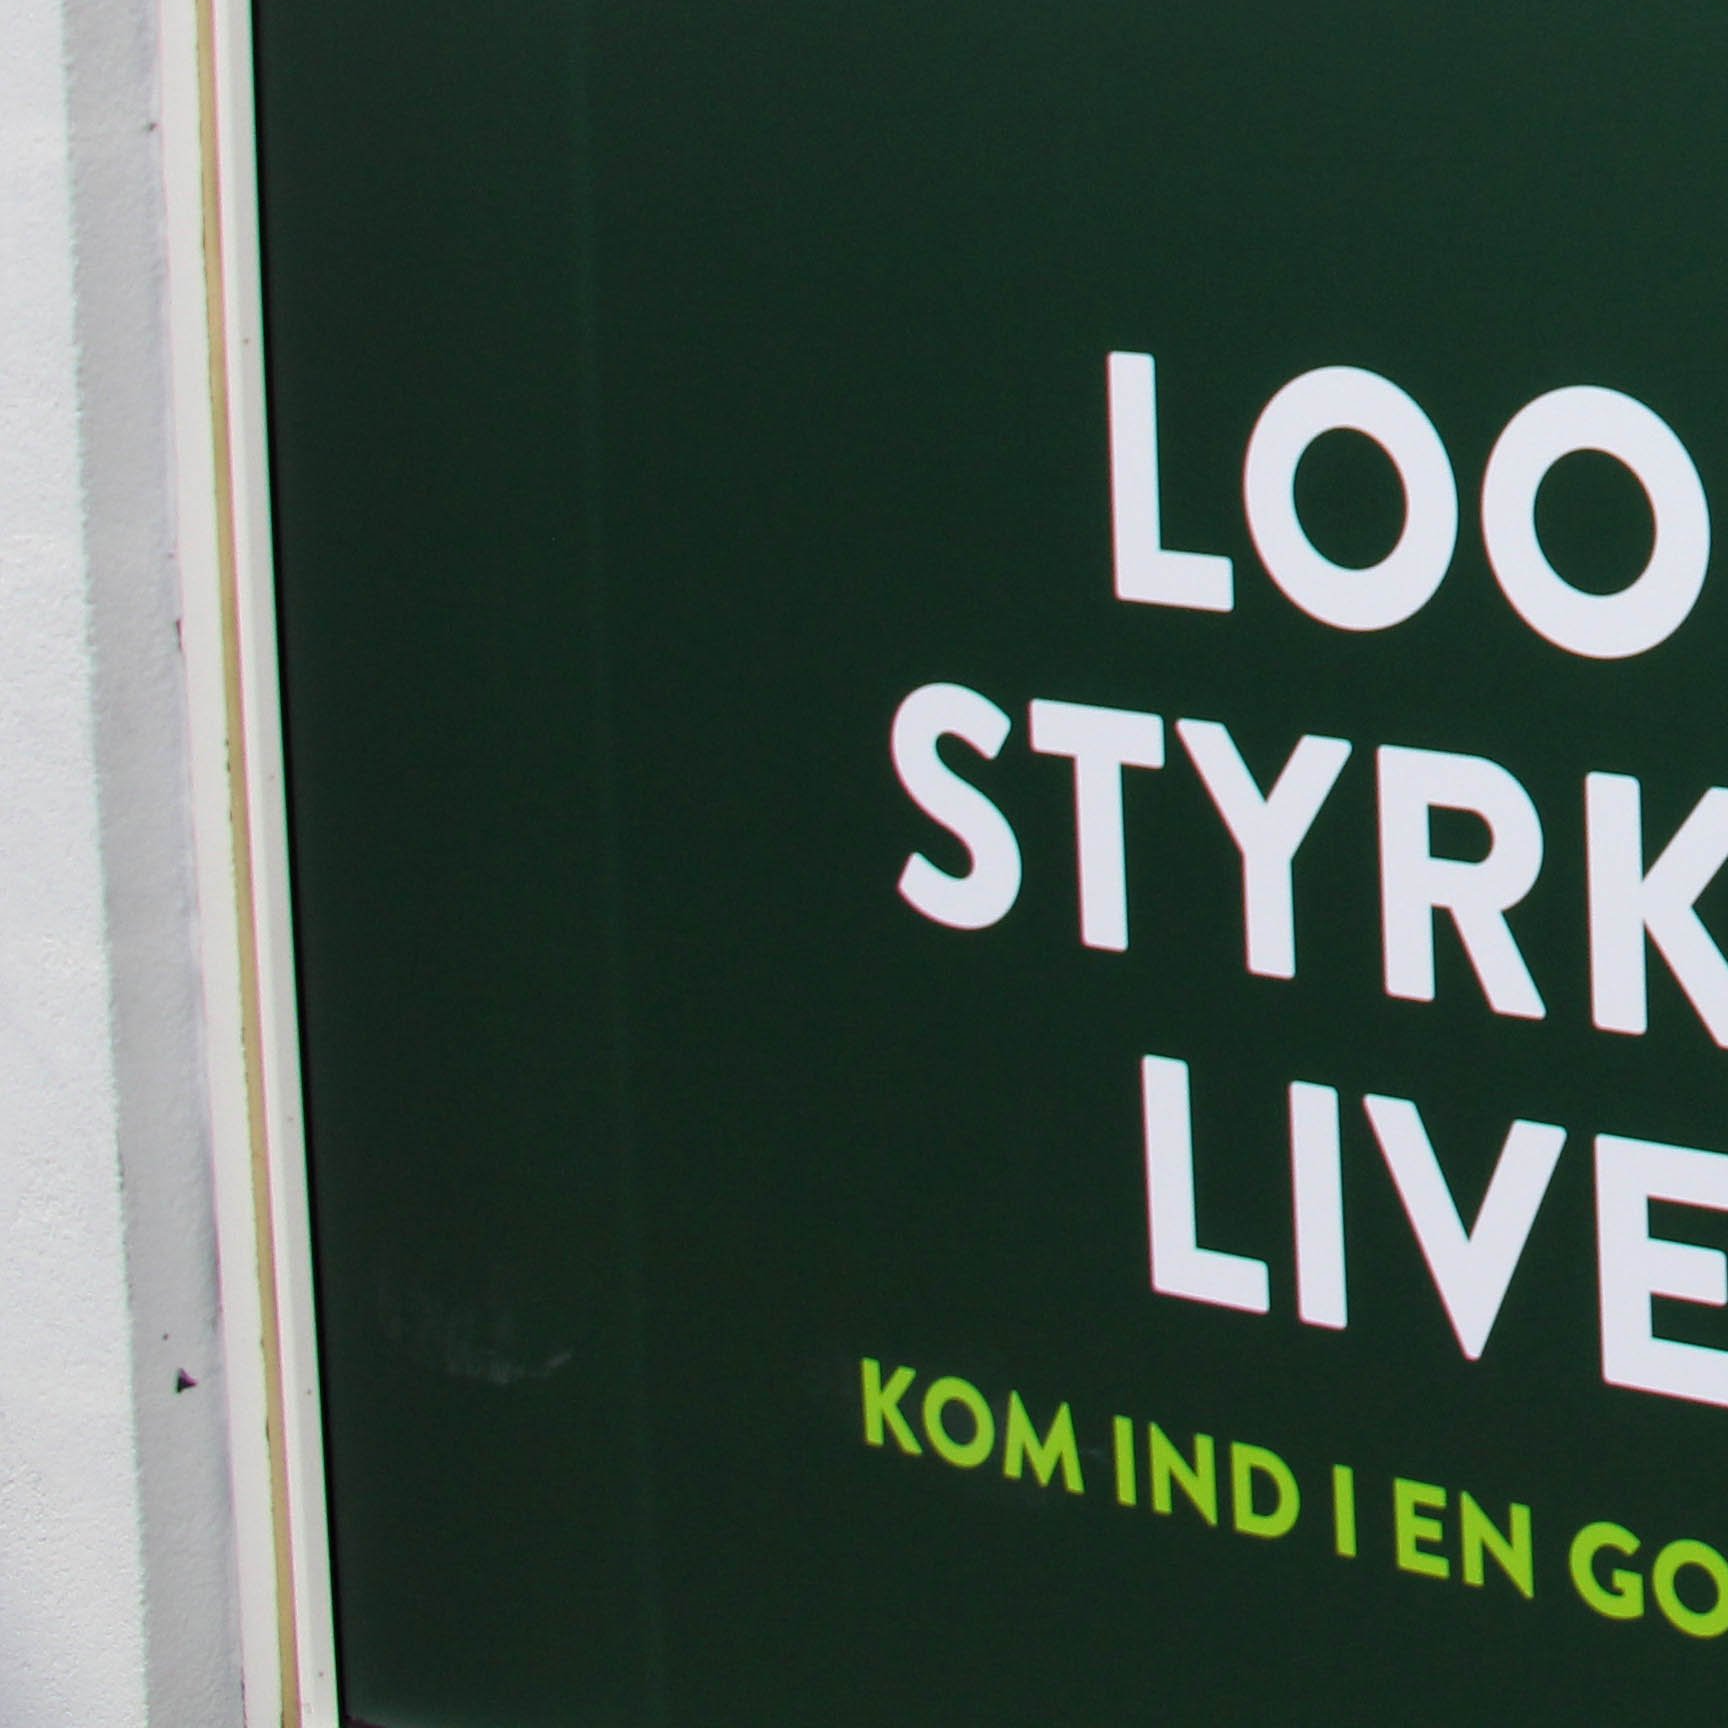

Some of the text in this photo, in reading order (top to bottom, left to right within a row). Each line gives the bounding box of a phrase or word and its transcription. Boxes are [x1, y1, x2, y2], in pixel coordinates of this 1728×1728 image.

[861, 1357, 1085, 1494] KOM
[1113, 1414, 1301, 1538] IND
[1332, 1463, 1357, 1558] I
[1393, 1477, 1535, 1599] EN
